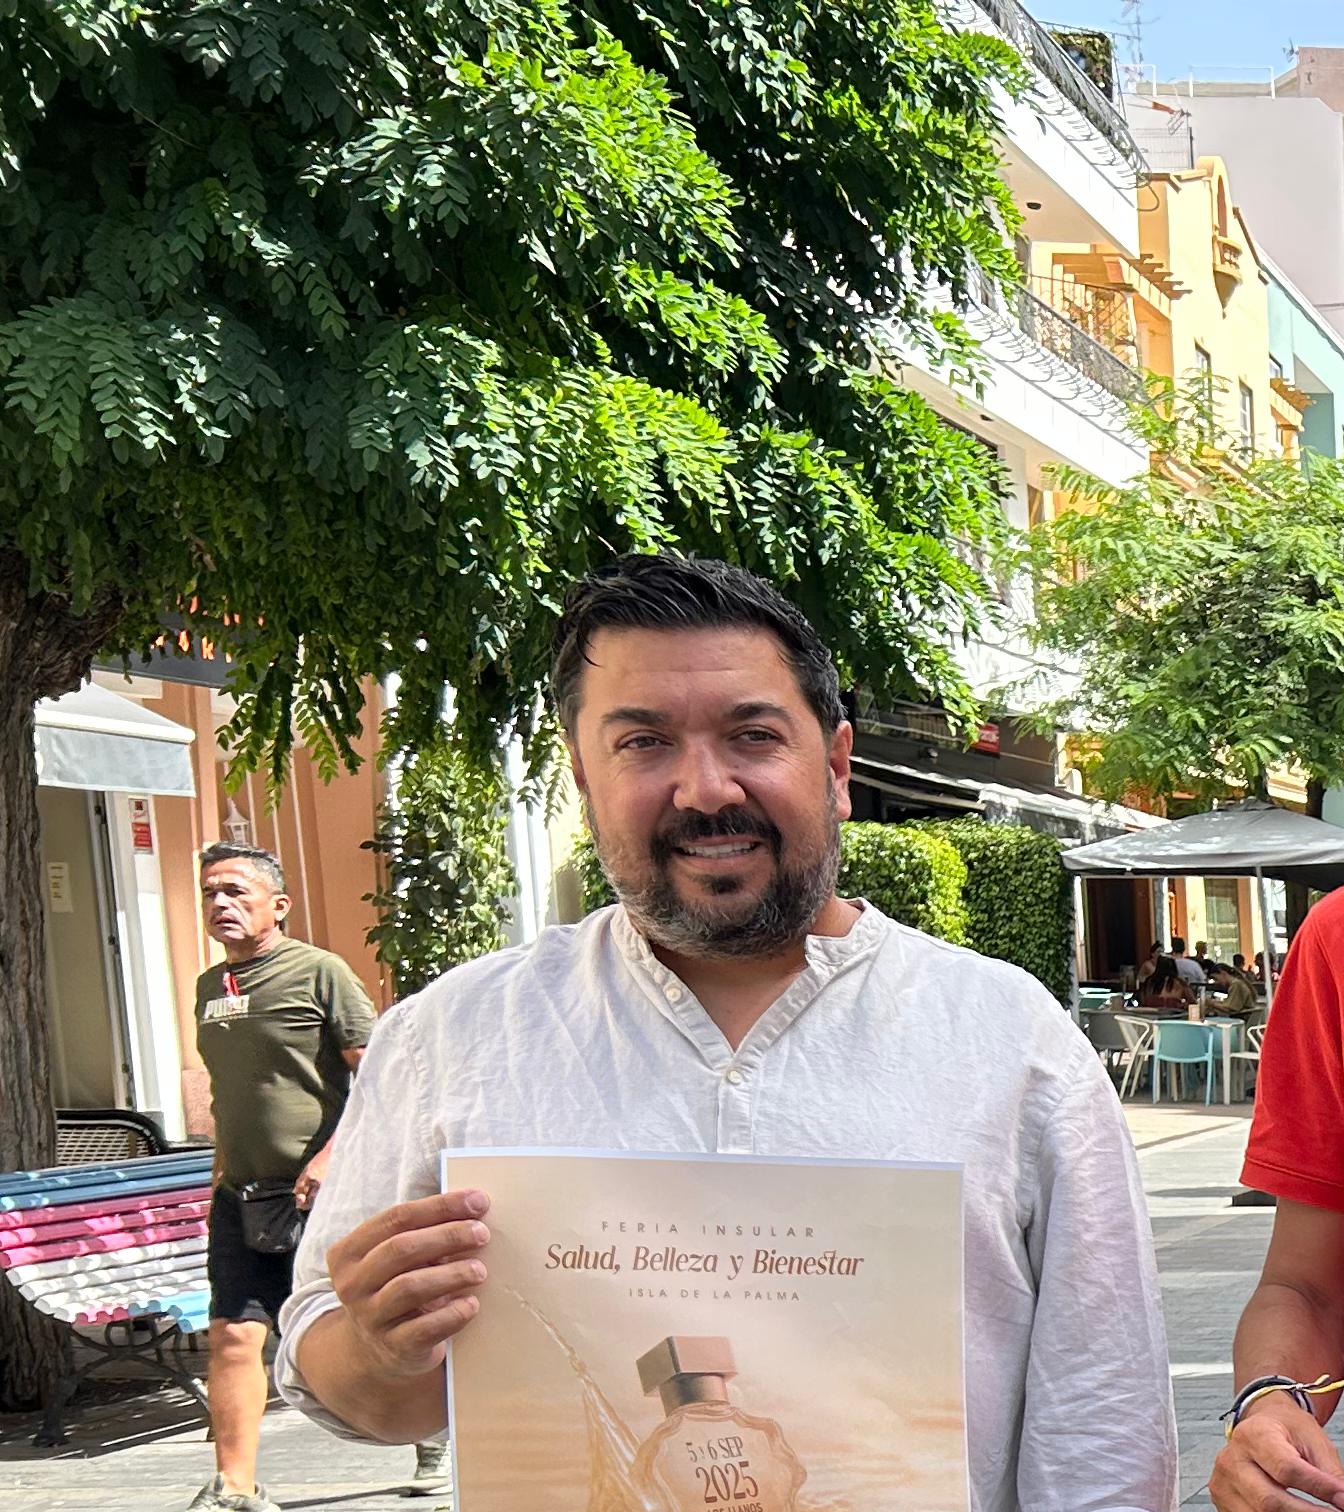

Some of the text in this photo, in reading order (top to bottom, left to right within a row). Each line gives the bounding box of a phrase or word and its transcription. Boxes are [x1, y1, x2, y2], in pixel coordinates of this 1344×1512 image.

[601, 1220, 814, 1238] FERIA INSULAR
[544, 1243, 865, 1281] Salud, Belleza y Bienestar
[629, 1287, 800, 1302] ISLA DE LA PALMA
[685, 1442, 698, 1463] 5
[706, 1439, 718, 1461] 6
[717, 1435, 743, 1459] SEP
[695, 1460, 759, 1504] 2025
